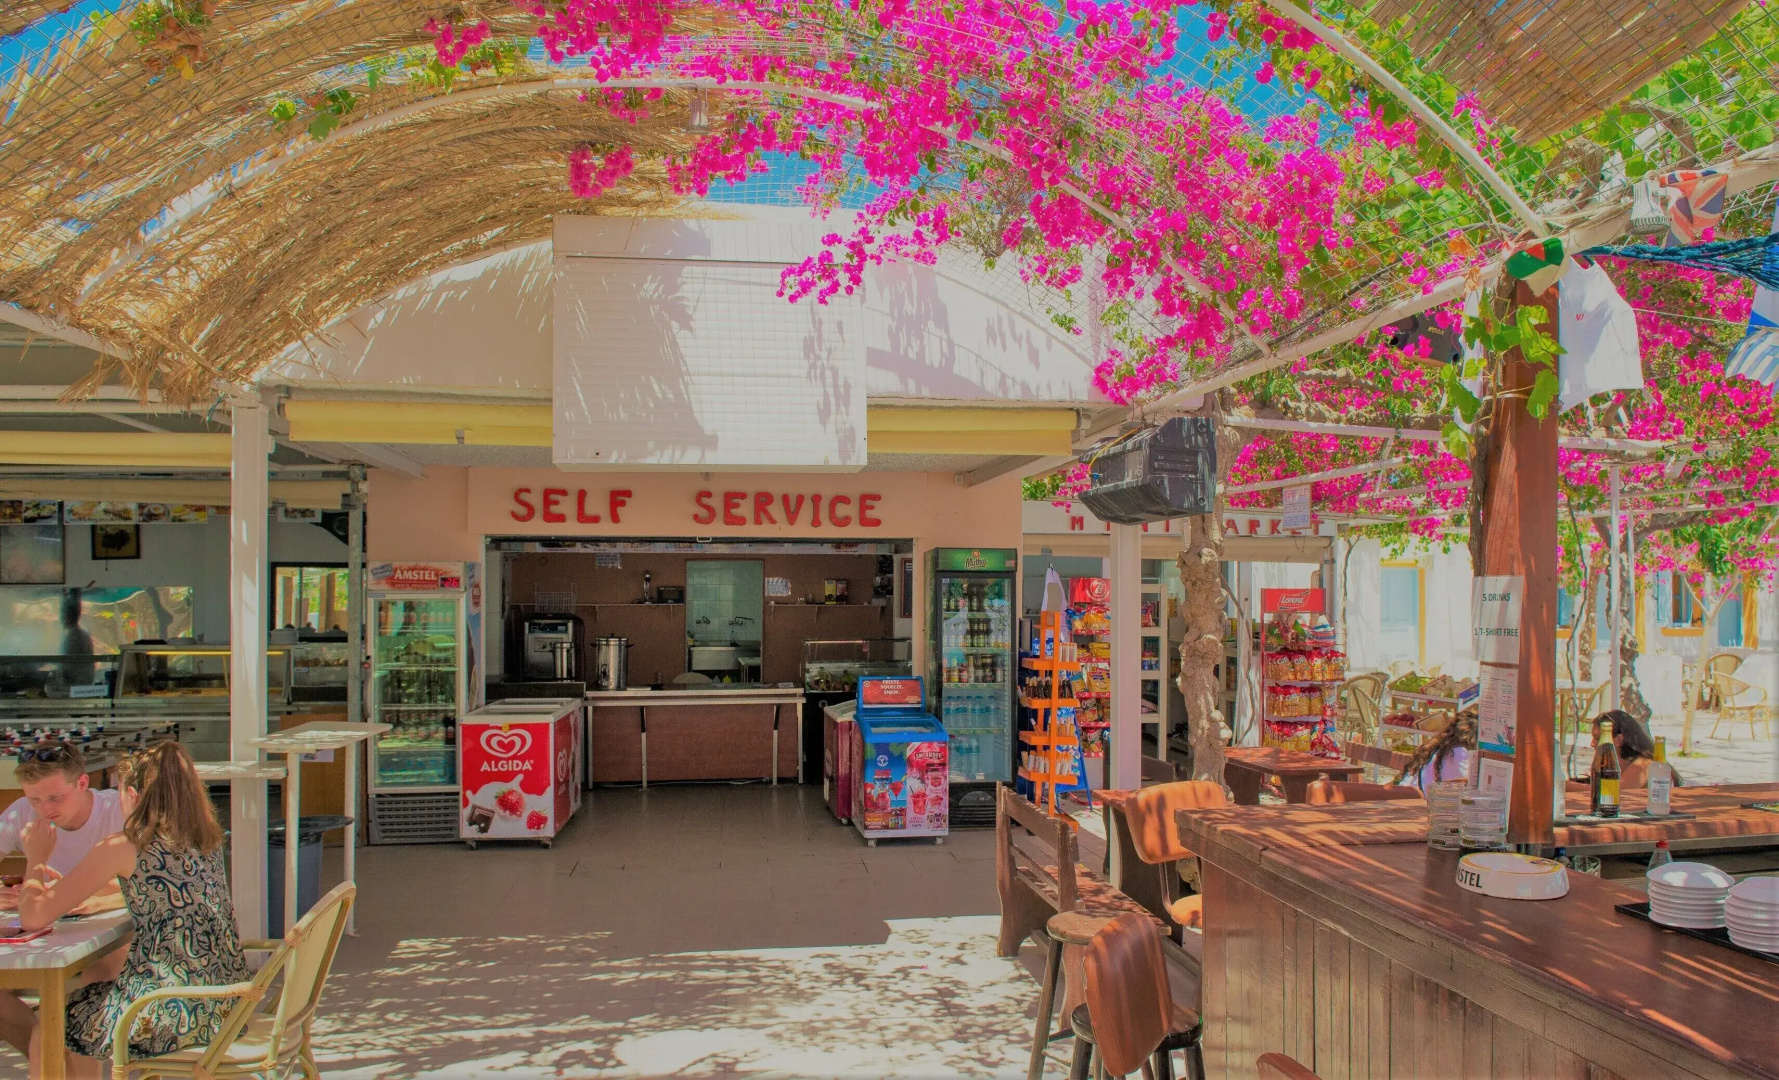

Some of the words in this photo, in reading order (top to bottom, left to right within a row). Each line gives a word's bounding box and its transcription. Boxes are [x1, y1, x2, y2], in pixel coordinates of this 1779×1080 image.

[511, 487, 633, 524] SELF
[693, 490, 882, 527] SERVICE
[1222, 518, 1325, 536] ARKT
[1482, 593, 1487, 602] 5
[1488, 592, 1511, 602] DRINKS
[1474, 627, 1479, 636] 1
[1479, 627, 1502, 637] T-SHIRT
[1503, 628, 1519, 637] FREE
[480, 760, 532, 772] ALGIDA
